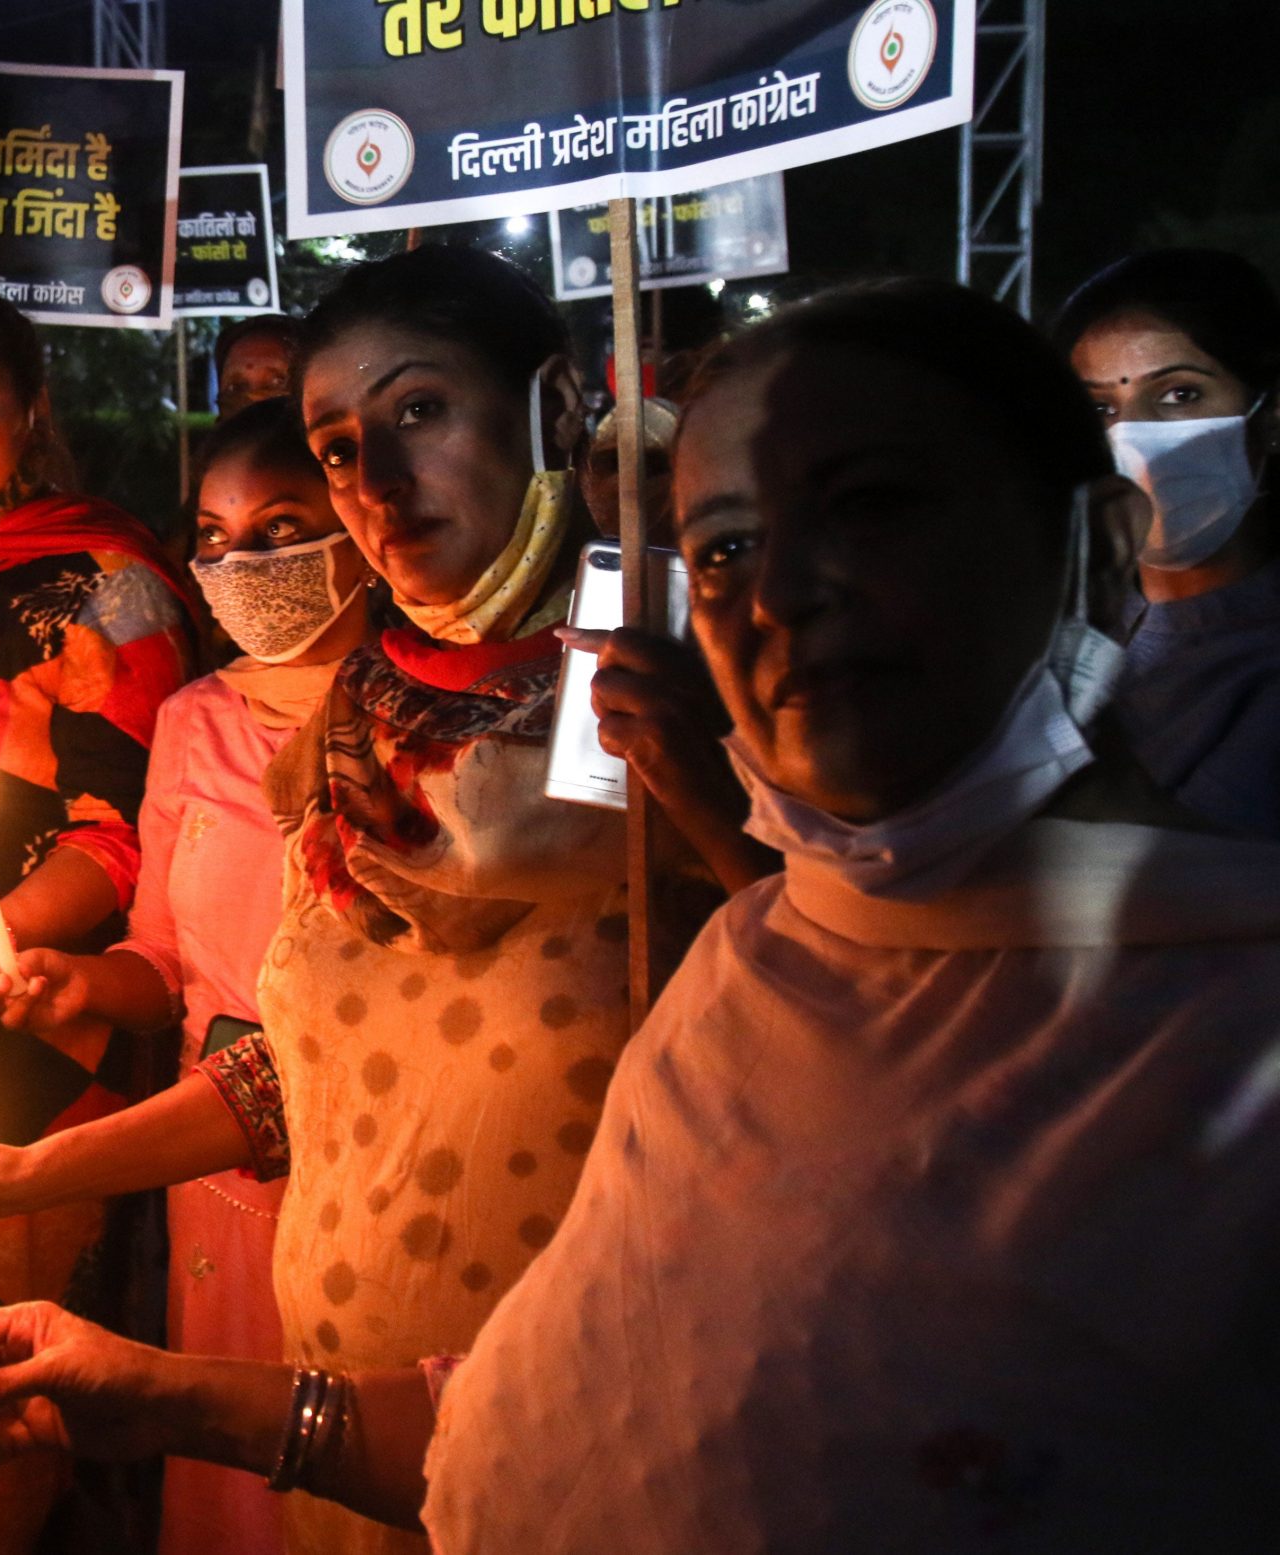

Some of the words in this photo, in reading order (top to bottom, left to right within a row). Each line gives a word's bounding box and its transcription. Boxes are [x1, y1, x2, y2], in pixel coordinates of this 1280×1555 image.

[447, 122, 545, 180] दिल्ली
[549, 114, 618, 167] प्रदेश
[623, 98, 729, 151] महिला
[729, 70, 820, 131] कांग्रेस
[85, 132, 112, 181] है
[13, 187, 90, 239] जिंदा
[94, 191, 121, 241] है
[177, 211, 235, 238] कातिलों
[236, 210, 257, 236] को
[33, 279, 85, 305] कांग्रेस
